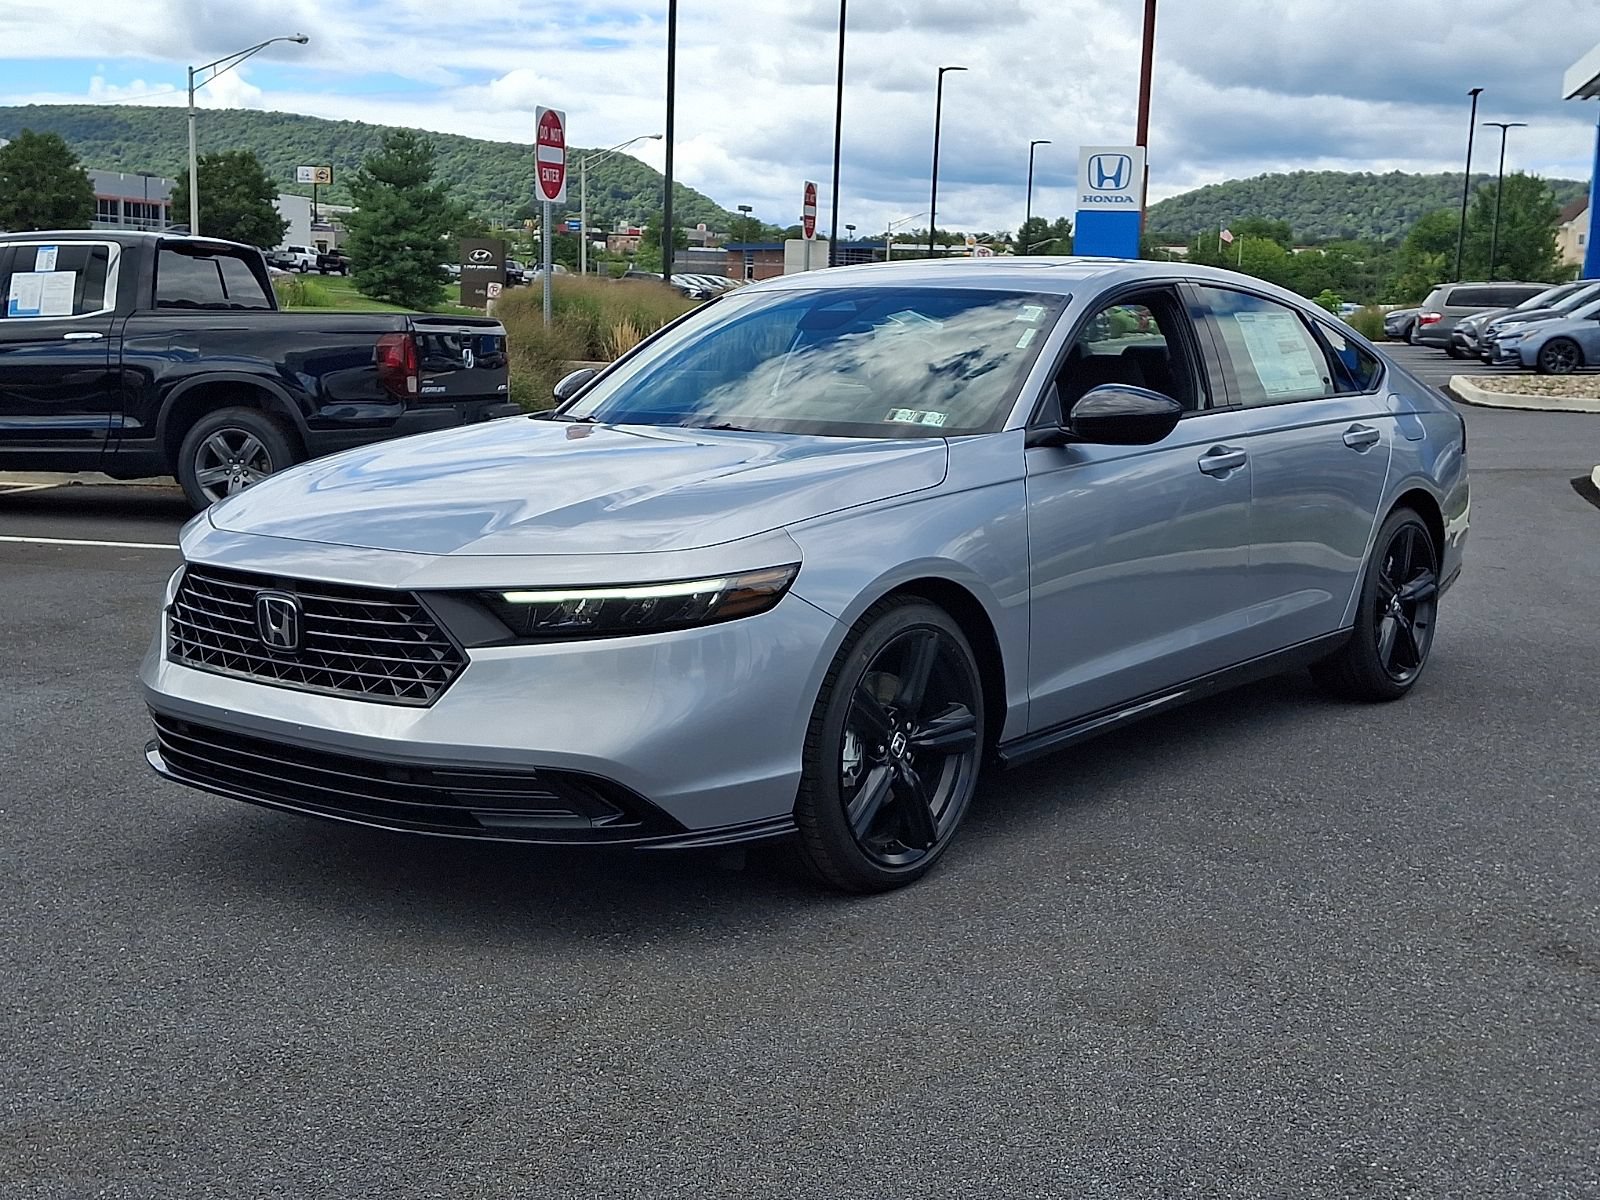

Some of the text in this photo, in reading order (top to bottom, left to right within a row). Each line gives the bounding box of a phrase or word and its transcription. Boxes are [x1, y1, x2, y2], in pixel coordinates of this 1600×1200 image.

[540, 125, 561, 142] DO NOT
[542, 167, 560, 183] ENTER
[1082, 195, 1134, 203] HONDA
